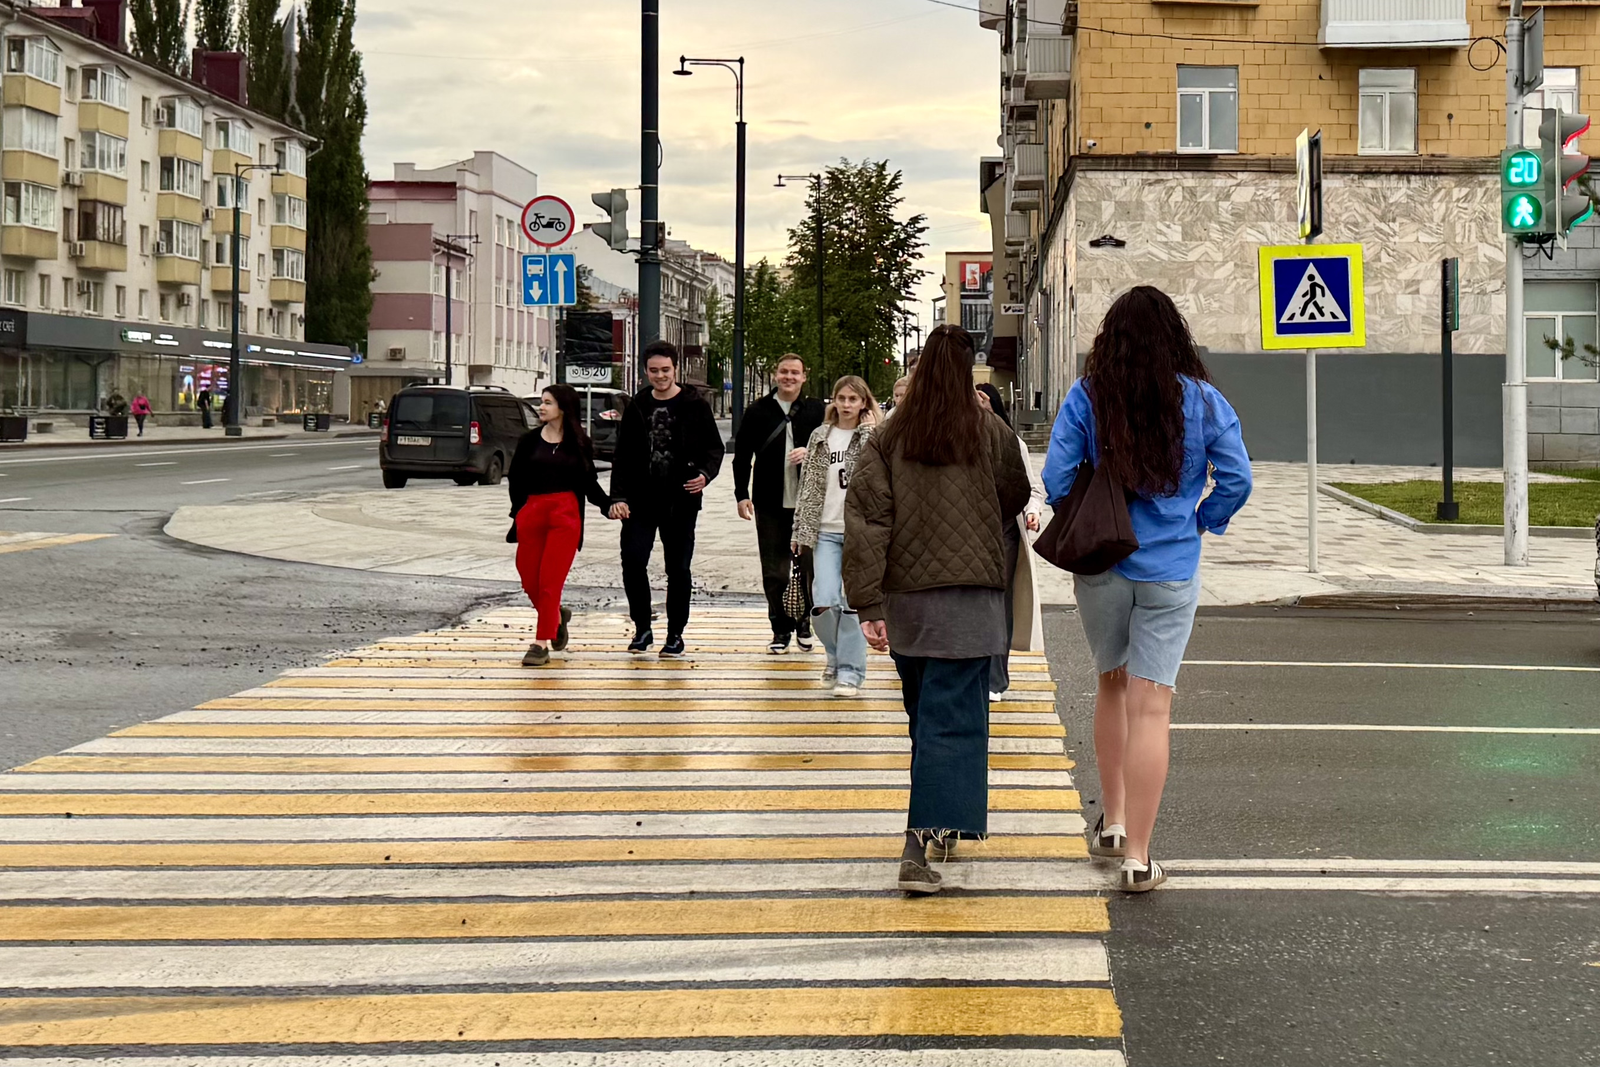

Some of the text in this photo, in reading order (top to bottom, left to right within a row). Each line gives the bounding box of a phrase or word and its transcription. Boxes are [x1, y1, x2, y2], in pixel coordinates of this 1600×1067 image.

[1510, 157, 1538, 184] 20
[581, 367, 590, 376] 15
[593, 366, 607, 377] 20
[830, 450, 847, 465] BU
